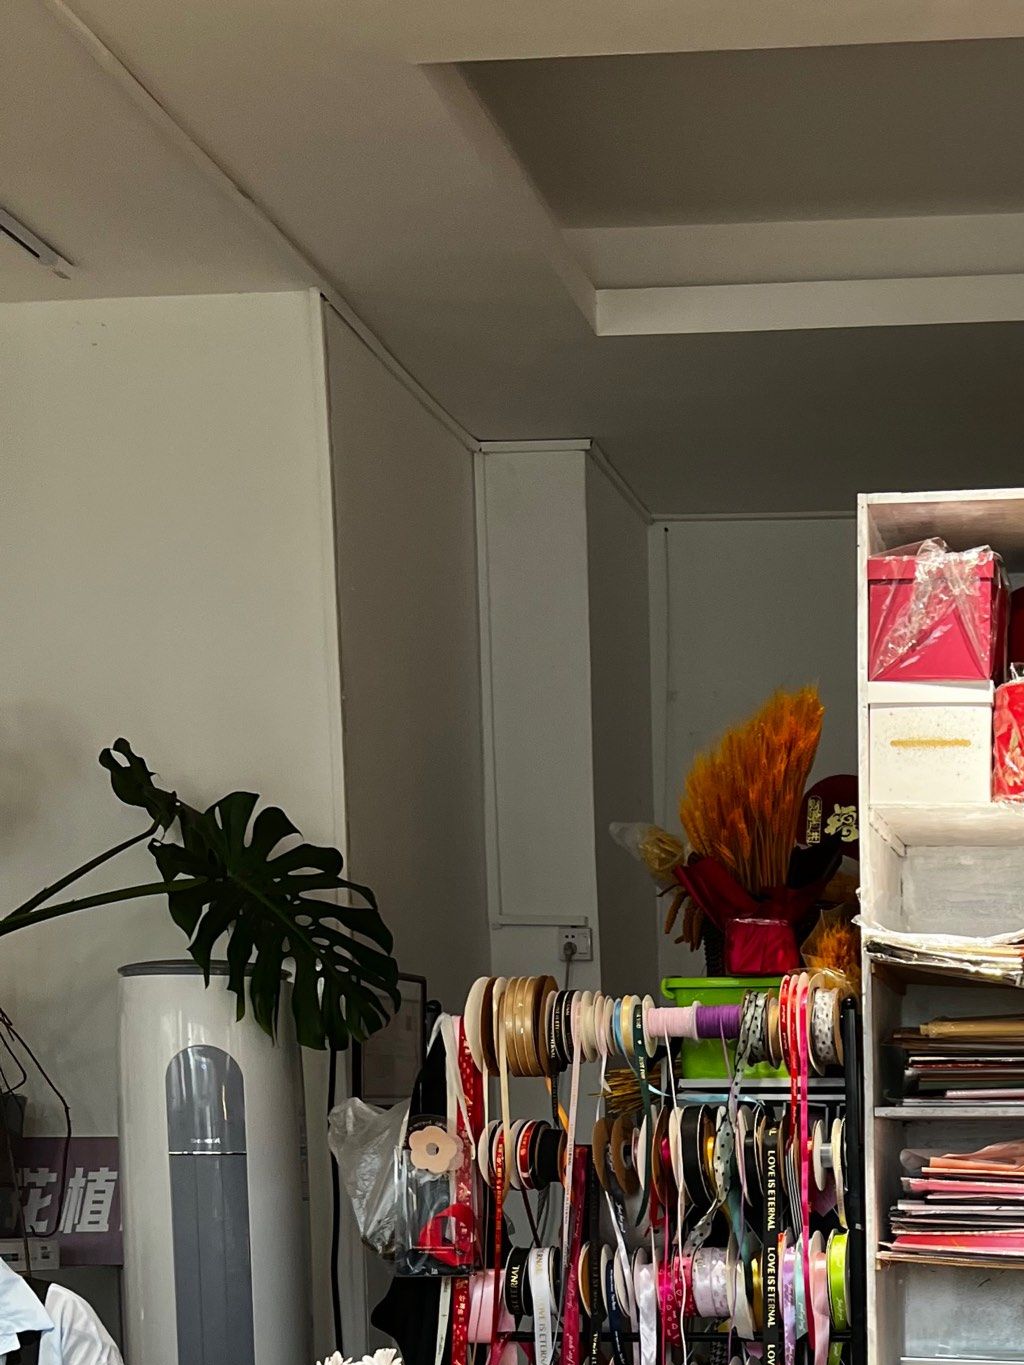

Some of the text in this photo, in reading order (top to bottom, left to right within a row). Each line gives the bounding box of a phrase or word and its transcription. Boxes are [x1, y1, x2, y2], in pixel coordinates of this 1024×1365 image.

[767, 1150, 776, 1232] LOVE IS ETERNAL
[767, 1247, 776, 1328] LOVE IS ETERNAL
